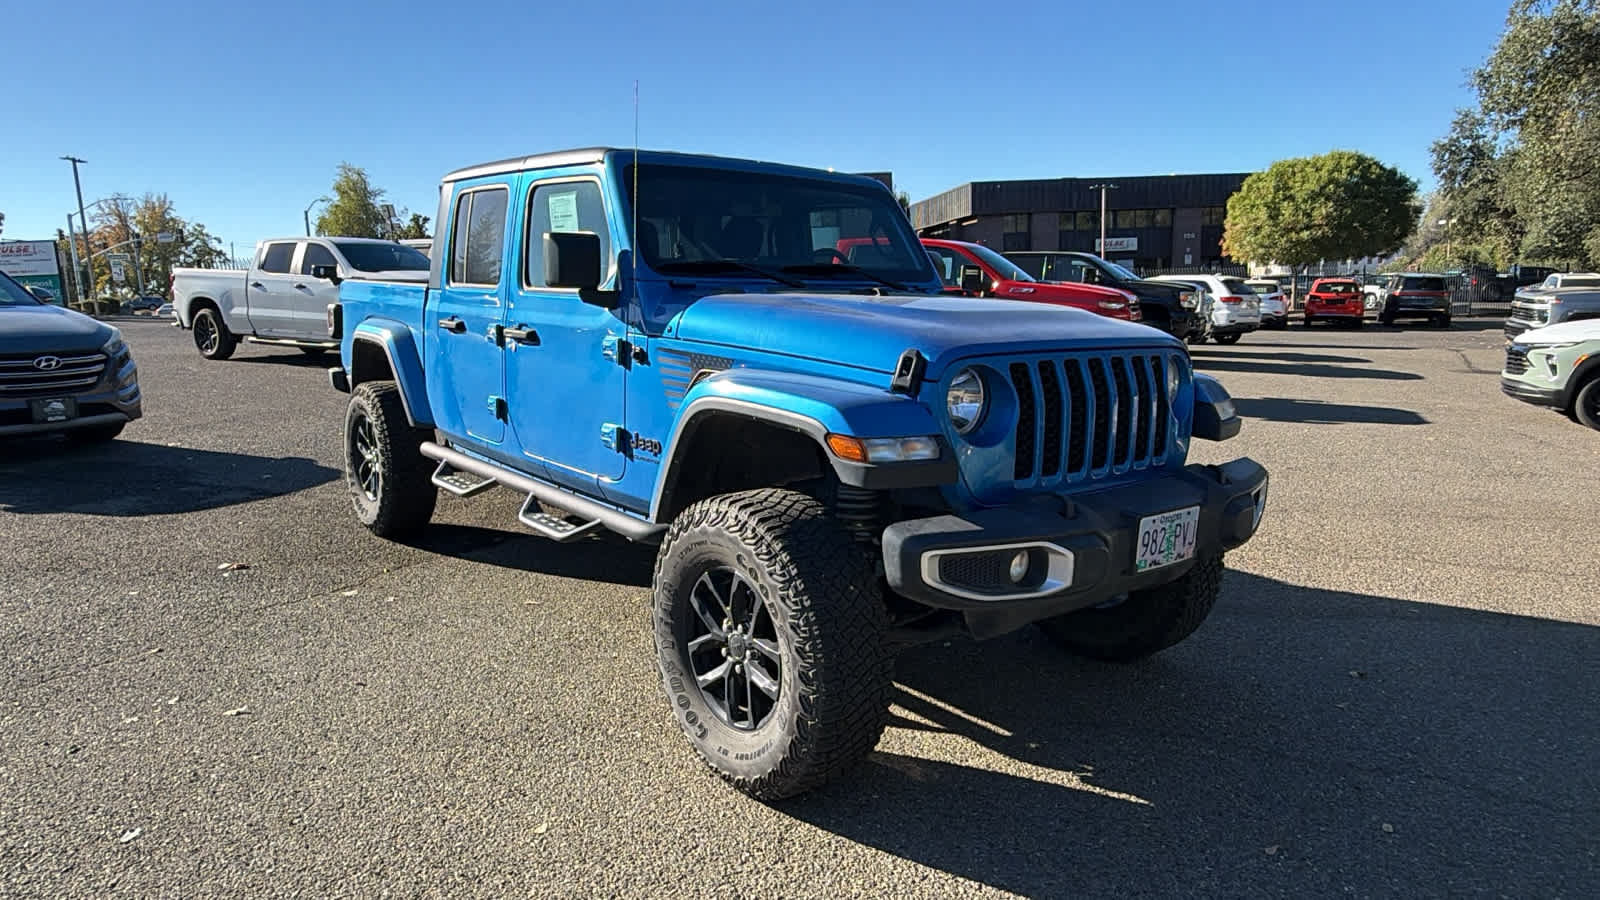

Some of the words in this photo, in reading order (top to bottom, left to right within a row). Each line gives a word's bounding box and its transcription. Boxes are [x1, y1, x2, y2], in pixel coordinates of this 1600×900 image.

[0, 245, 30, 254] ULSE
[630, 432, 663, 457] Jeep
[1142, 527, 1166, 557] 982
[1173, 522, 1197, 551] PVJ
